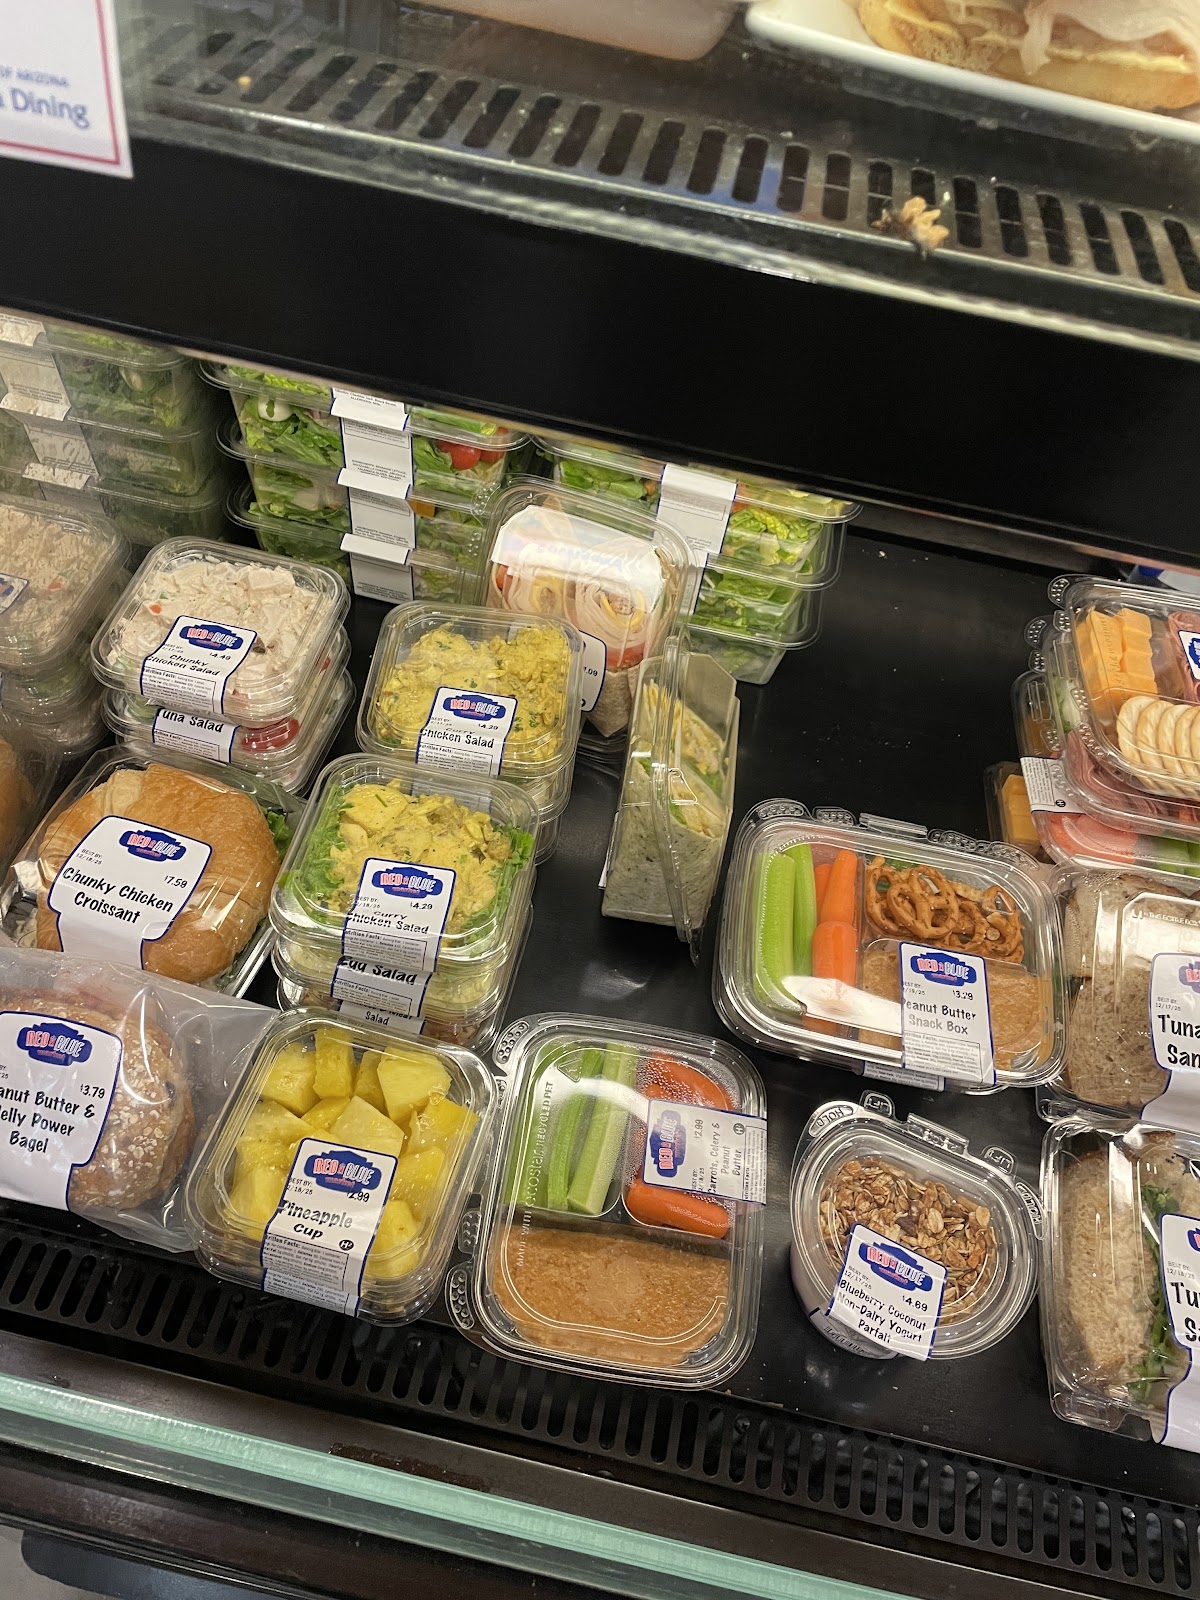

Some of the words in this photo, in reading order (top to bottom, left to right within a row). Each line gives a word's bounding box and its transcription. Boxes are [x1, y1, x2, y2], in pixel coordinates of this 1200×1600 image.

[10, 88, 90, 129] Dining
[187, 628, 208, 640] RED
[147, 656, 187, 669] Chicken
[189, 665, 221, 676] Salad
[169, 654, 209, 667] Chunky
[450, 699, 470, 710] RED
[475, 701, 501, 717] BLUE
[162, 710, 185, 723] una
[189, 716, 224, 733] Salad
[445, 727, 476, 735] Curry
[421, 729, 461, 743] Chicken
[465, 735, 495, 749] Salad
[127, 833, 151, 848] RED
[153, 840, 181, 857] BLUE
[62, 867, 117, 895] Chunky
[118, 885, 174, 913] Chicken
[163, 874, 188, 889] $7.59
[380, 872, 403, 886] RED
[408, 875, 437, 893] BLUE
[74, 891, 141, 924] Croissant
[373, 911, 408, 920] Curry
[409, 901, 433, 910] $4.29
[347, 912, 391, 928] Chicken
[395, 920, 430, 935] Salad
[372, 964, 418, 986] Salad
[917, 958, 938, 972] RED
[944, 961, 970, 980] BLUE
[365, 1011, 390, 1026] Salad
[941, 1004, 977, 1021] Butter
[908, 1014, 943, 1031] Snack
[946, 1020, 969, 1035] Box
[25, 1030, 49, 1048] RED
[54, 1034, 86, 1058] BLUE
[80, 1083, 106, 1099] $3.79
[0, 1086, 30, 1104] anut
[35, 1091, 80, 1116] Butter
[83, 1104, 95, 1119] &
[865, 1097, 890, 1114] LIFT
[0, 1105, 26, 1127] elly
[31, 1112, 75, 1137] Power
[536, 1100, 551, 1148] RECYCLED
[544, 1081, 554, 1099] PET
[815, 1106, 845, 1127] HOLD
[660, 1117, 678, 1143] BLUE
[9, 1130, 50, 1153] Bagel
[709, 1131, 721, 1158] Celery
[658, 1148, 674, 1170] RED
[720, 1145, 731, 1175] Peanut
[732, 1149, 743, 1176] Butter
[986, 1149, 1013, 1169] LIFT
[313, 1157, 339, 1176] RED
[343, 1162, 375, 1186] BLUE
[707, 1160, 720, 1194] Carrots,
[286, 1184, 313, 1196] 2/18/25
[282, 1199, 354, 1229] Pineapple
[293, 1223, 324, 1240] Cup
[848, 1265, 861, 1277] BEST
[866, 1246, 891, 1268] RED
[895, 1260, 927, 1286] BLUE
[844, 1270, 872, 1290] 12/17/25
[839, 1279, 885, 1310] Blueberry
[888, 1304, 927, 1331] Coconut
[902, 1294, 928, 1313] $4.69
[1170, 1281, 1200, 1308] Tu
[837, 1291, 886, 1325] Non-Dairy
[889, 1319, 922, 1342] Yogurt
[858, 1319, 891, 1344] Parfait
